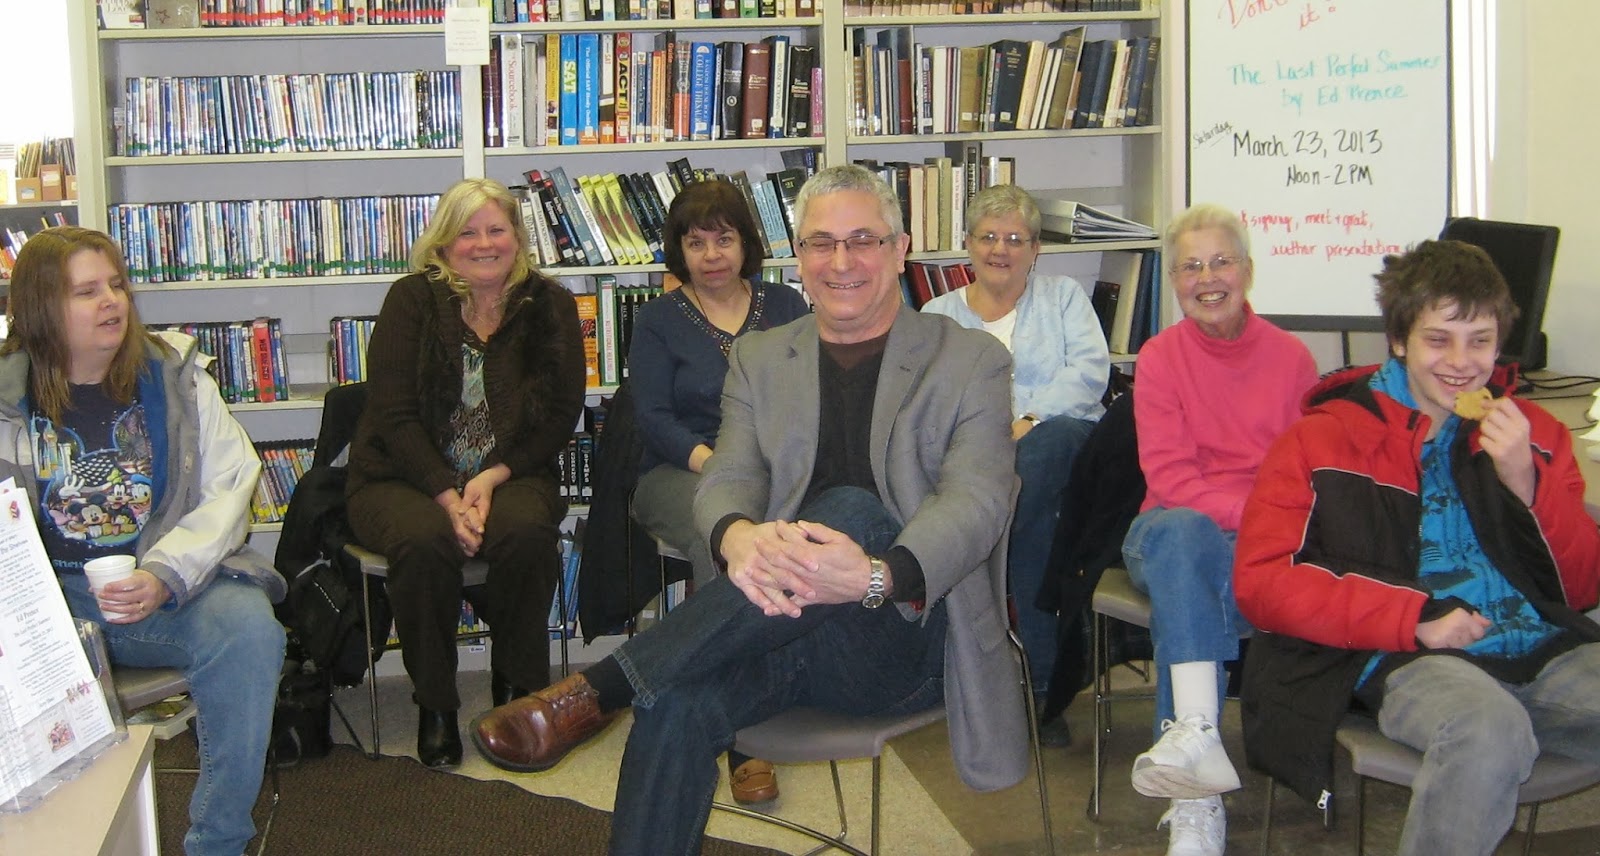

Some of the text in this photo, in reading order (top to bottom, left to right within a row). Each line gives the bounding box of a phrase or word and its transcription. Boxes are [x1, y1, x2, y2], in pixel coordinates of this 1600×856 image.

[667, 42, 675, 63] Guide
[1227, 63, 1265, 85] The
[1276, 60, 1315, 80] Last
[1376, 49, 1441, 74] Summer
[507, 59, 517, 111] Sourcebook
[564, 60, 576, 93] SAT
[619, 62, 628, 100] ACT
[693, 54, 704, 123] COLLEGE THESAUR
[1281, 88, 1303, 116] by
[1317, 85, 1339, 106] Ed
[1193, 120, 1234, 145] Saturday
[1233, 129, 1383, 158] March 23, 2013
[1305, 209, 1332, 225] meet
[1271, 239, 1400, 262] author presentation
